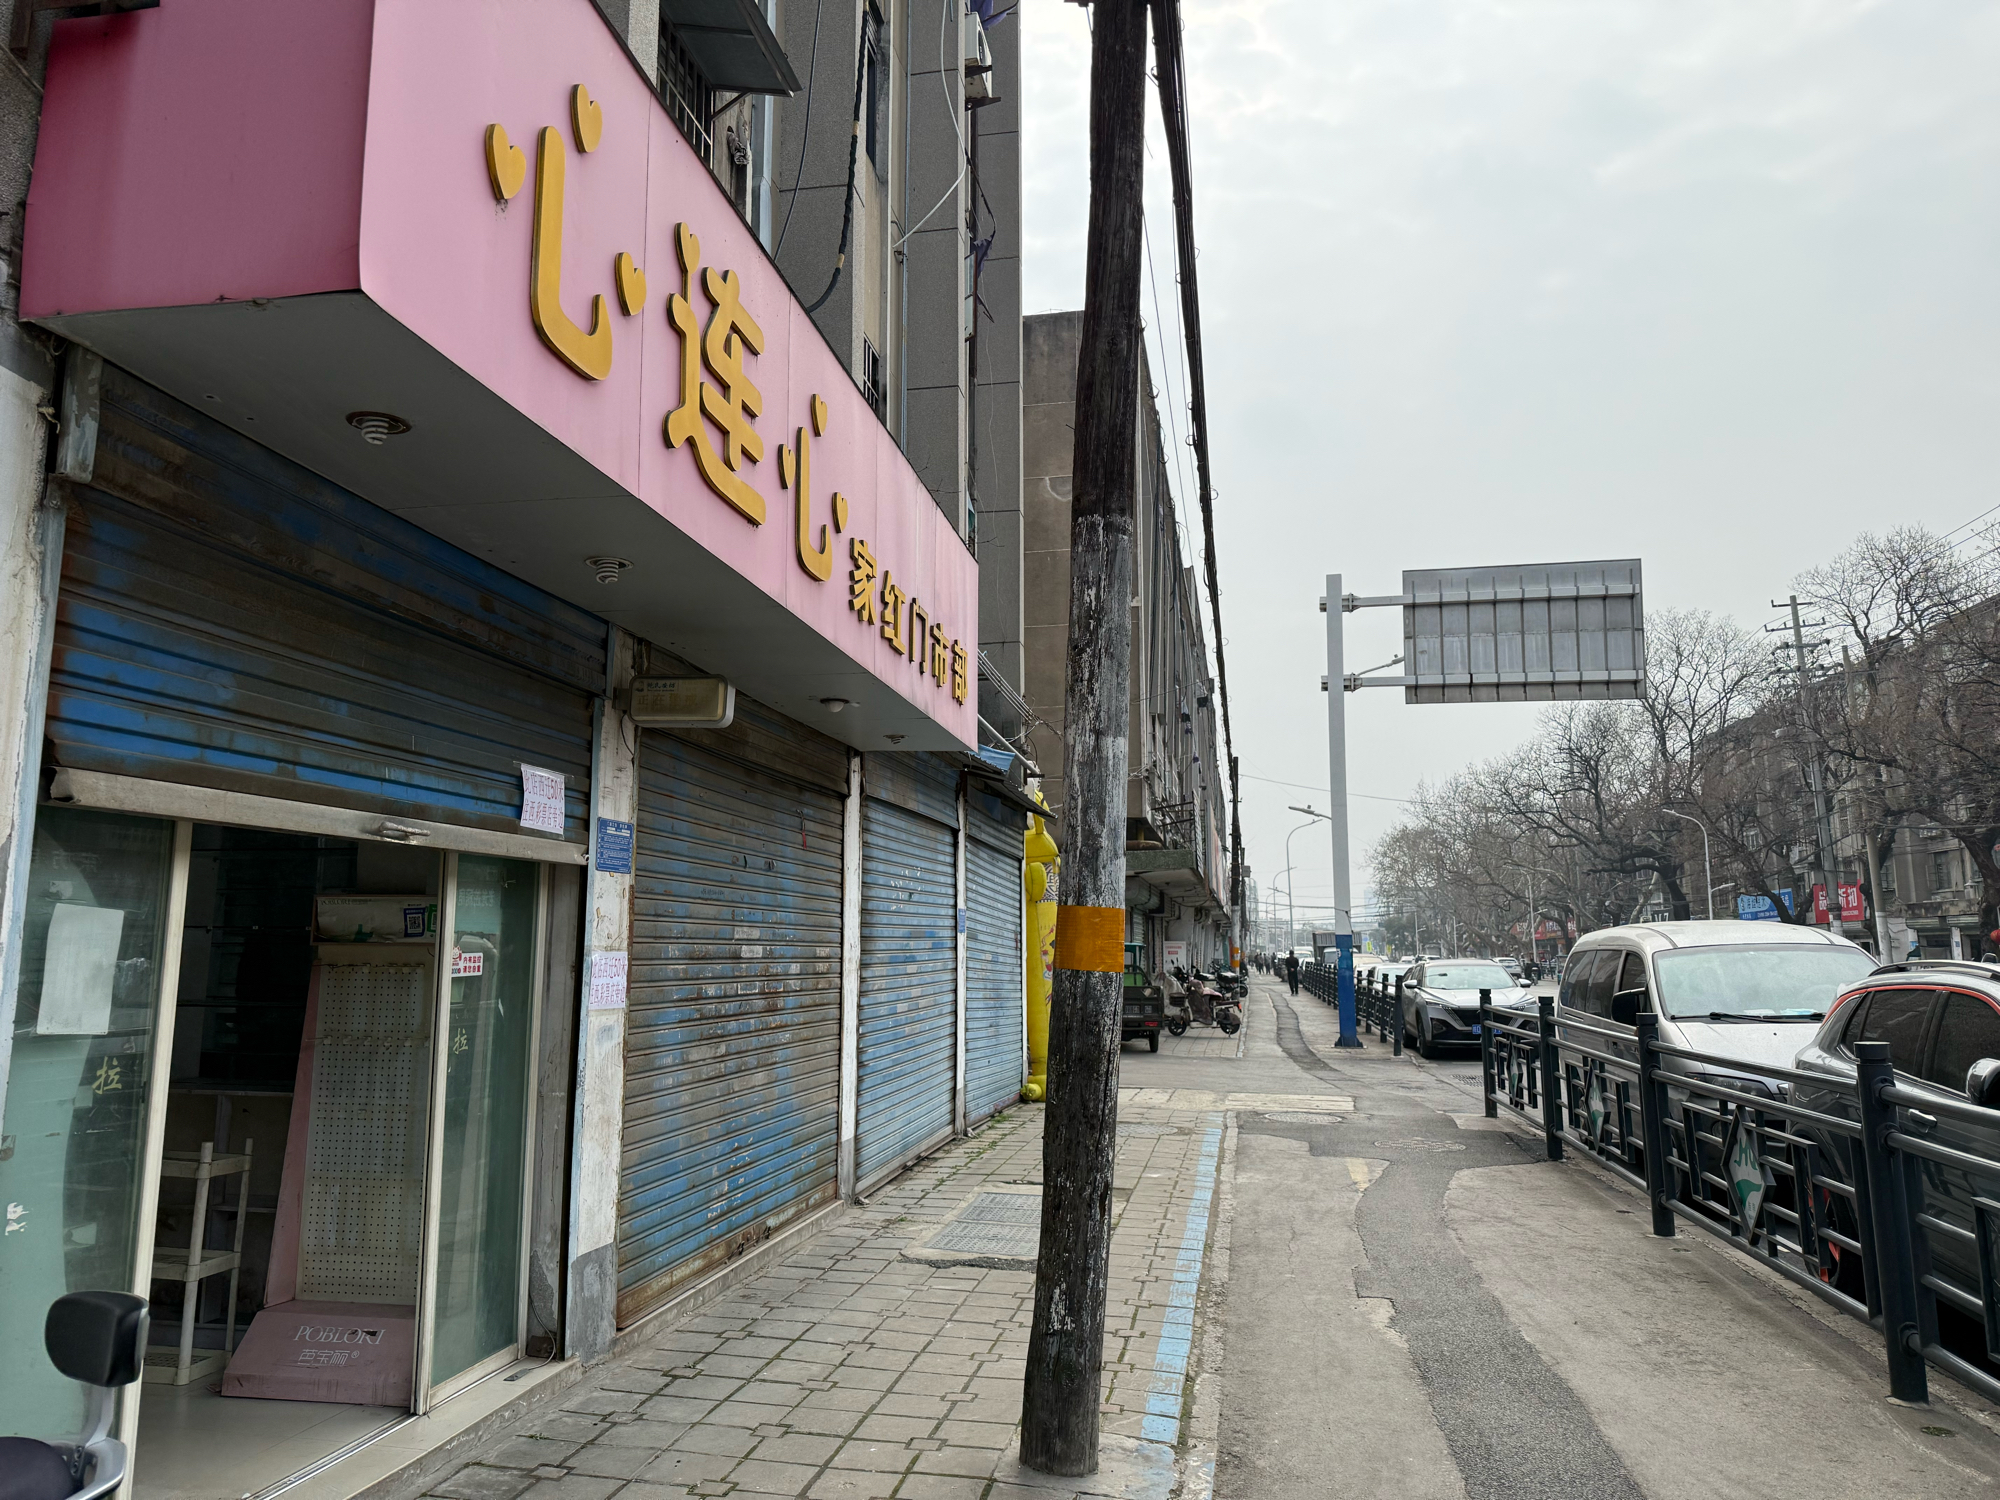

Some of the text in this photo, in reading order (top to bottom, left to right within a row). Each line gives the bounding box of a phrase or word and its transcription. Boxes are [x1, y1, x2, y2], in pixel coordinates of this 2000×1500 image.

[462, 955, 482, 965] 内有监控
[452, 1027, 468, 1055] 拉
[92, 1056, 122, 1094] 拉
[293, 1325, 386, 1345] POBLORI
